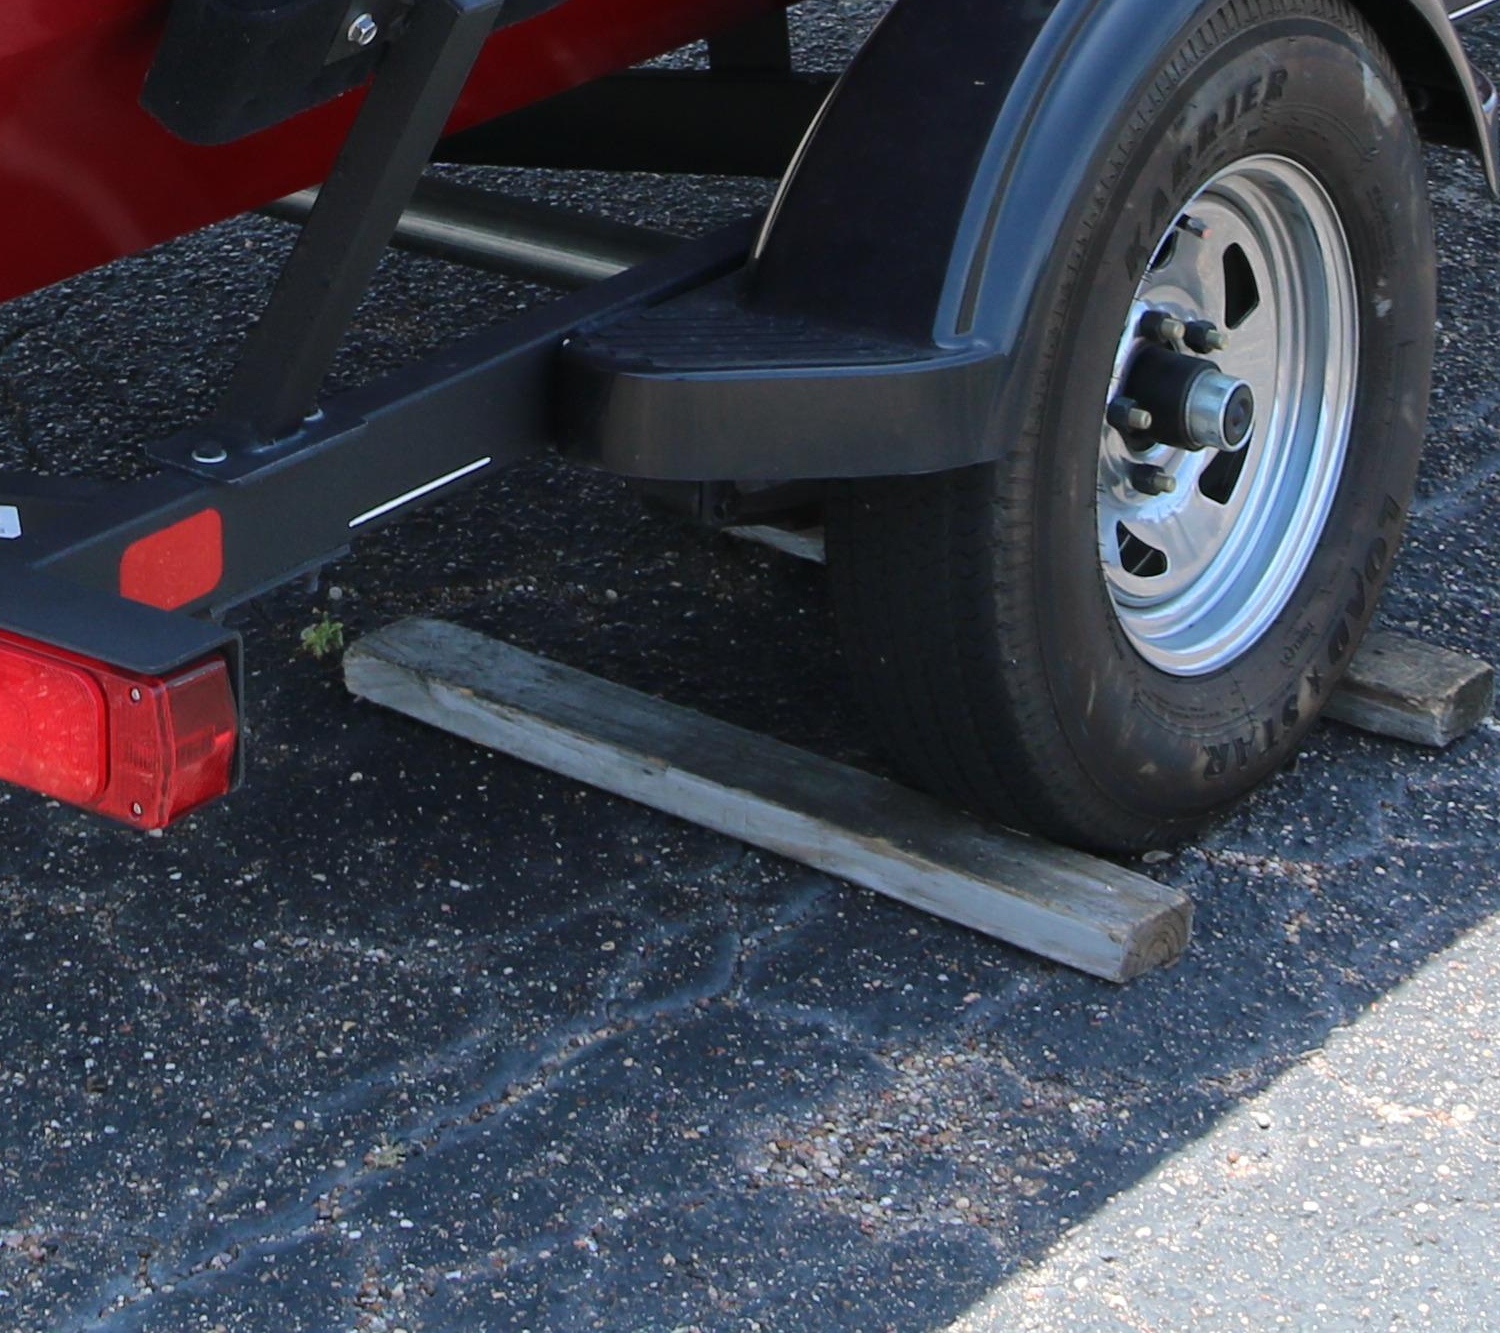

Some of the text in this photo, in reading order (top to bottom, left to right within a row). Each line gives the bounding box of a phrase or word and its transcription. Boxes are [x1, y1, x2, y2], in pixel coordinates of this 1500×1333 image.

[1125, 67, 1289, 282] KARRIER
[1327, 492, 1401, 666] LOAD
[1202, 692, 1299, 780] STAR
